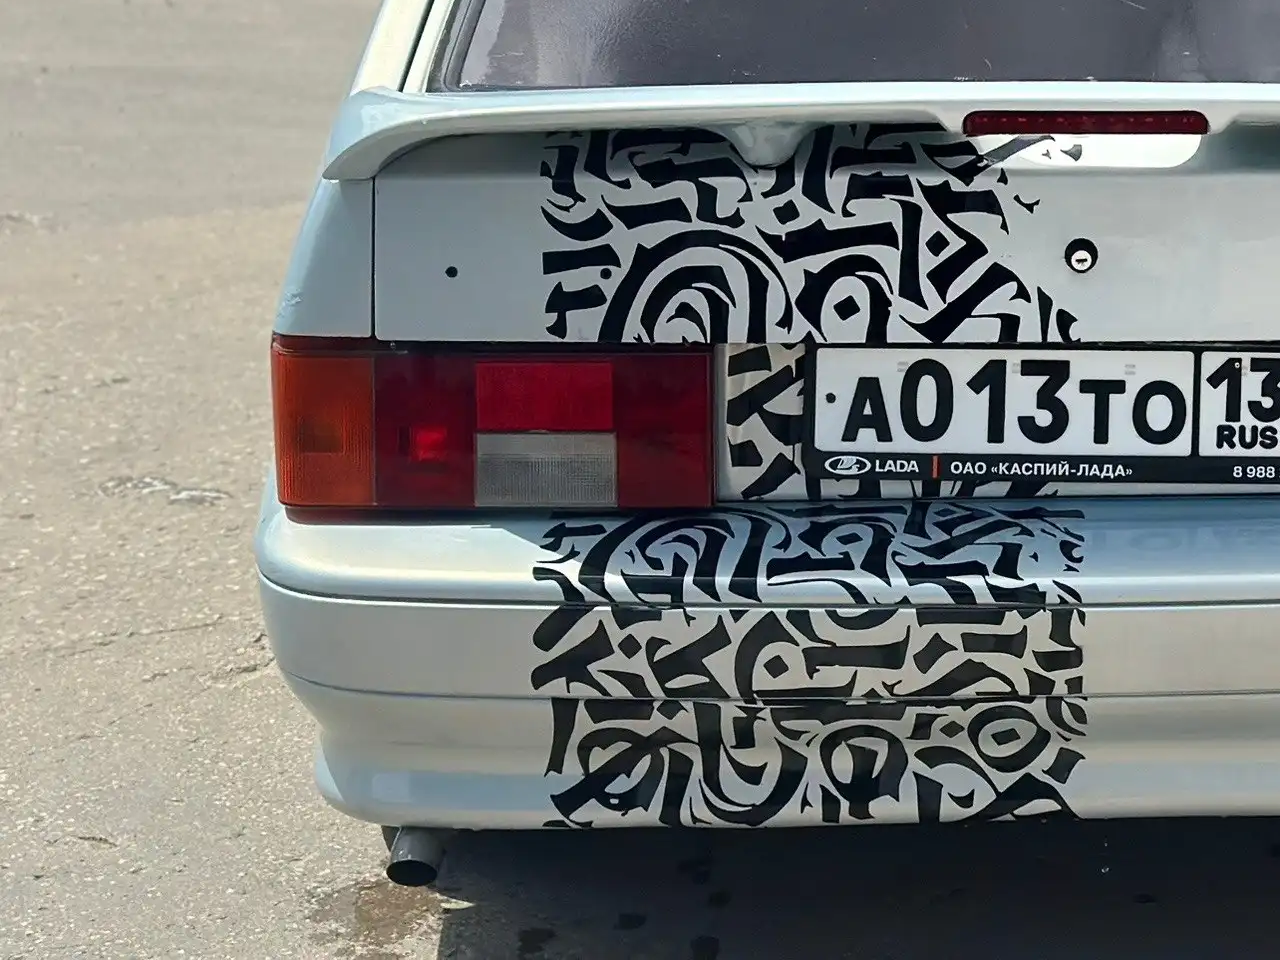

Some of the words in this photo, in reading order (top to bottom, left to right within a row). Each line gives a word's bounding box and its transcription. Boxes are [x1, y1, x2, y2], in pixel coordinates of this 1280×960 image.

[1215, 424, 1279, 450] RUS
[874, 458, 920, 474] LADA
[949, 460, 988, 476] ОАО
[990, 459, 1134, 480] «КАСПИЙ-ЛАДА»
[1231, 464, 1244, 479] 8
[1245, 464, 1277, 480] 988
